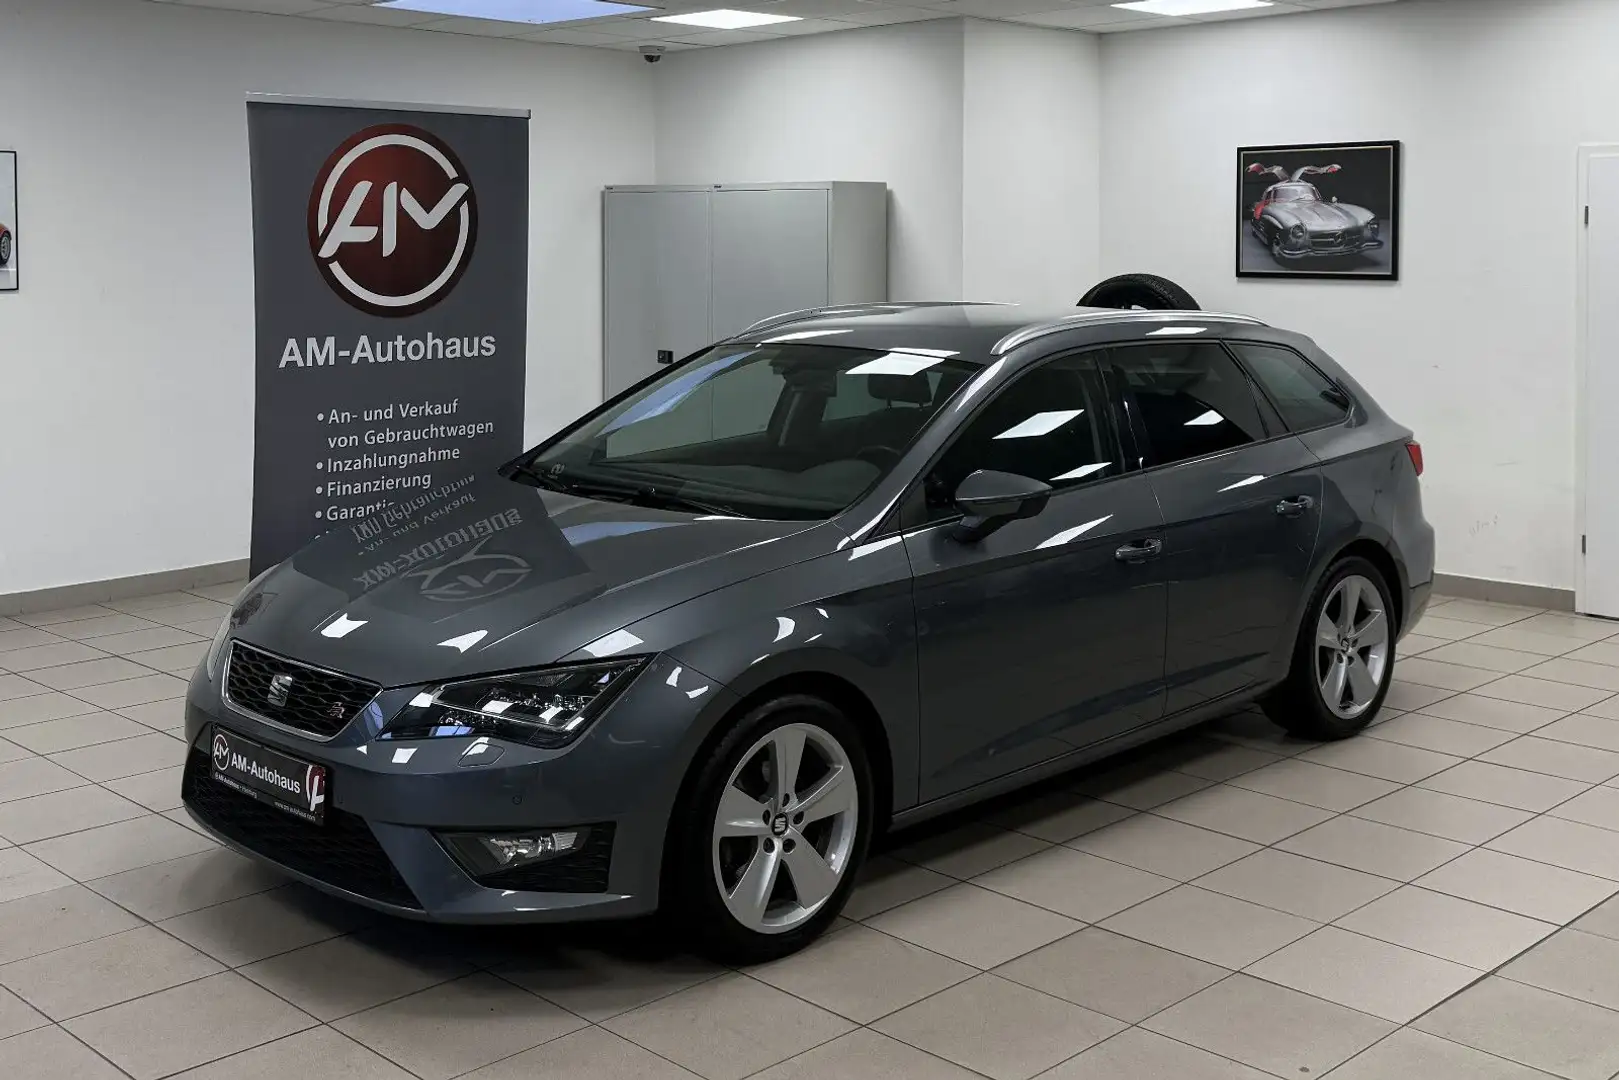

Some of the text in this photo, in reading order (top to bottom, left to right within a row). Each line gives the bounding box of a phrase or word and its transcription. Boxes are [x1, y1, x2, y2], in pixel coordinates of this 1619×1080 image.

[279, 332, 496, 368] AM-Autohaus
[328, 398, 459, 424] An- und Verkauf
[327, 421, 494, 448] von Gebrauchtwagen
[327, 448, 460, 472] Inzahlungnahme
[327, 474, 432, 497] Finanzierung
[231, 752, 301, 794] AM-Autohaus
